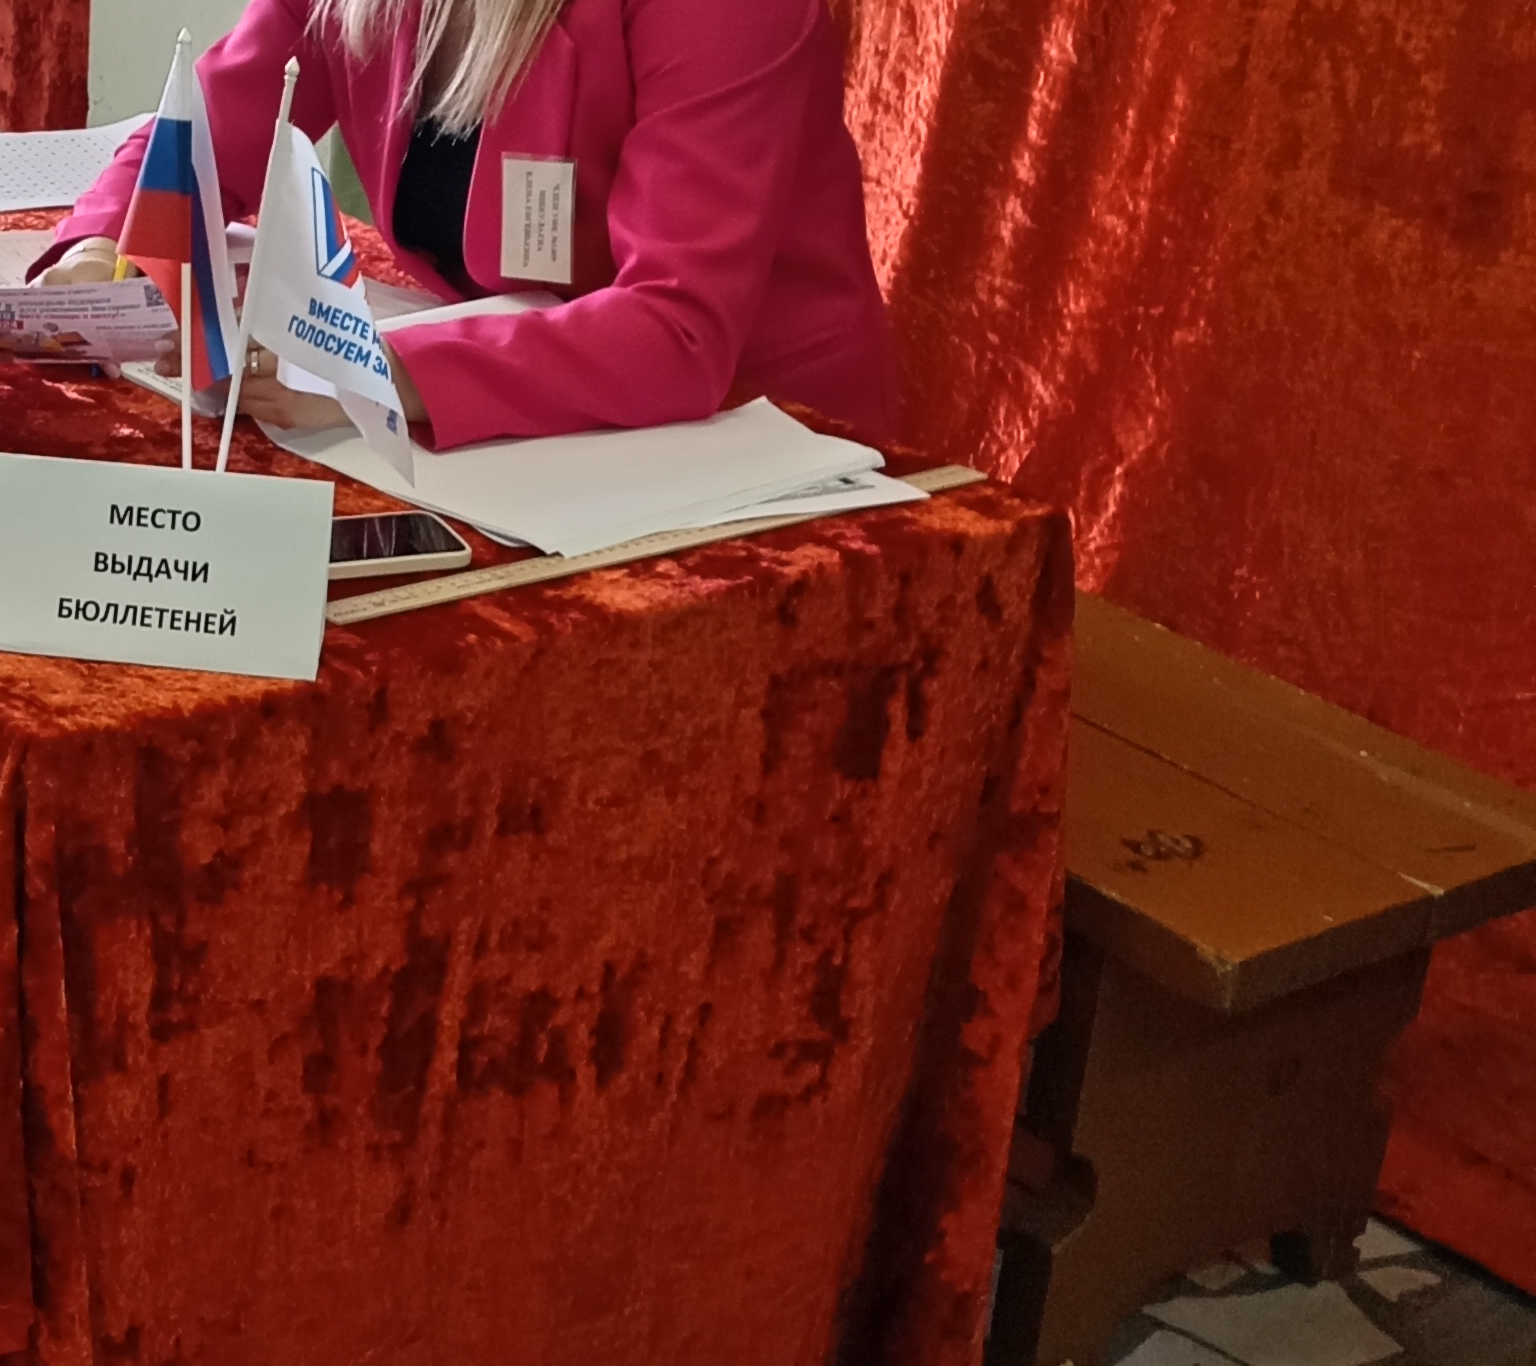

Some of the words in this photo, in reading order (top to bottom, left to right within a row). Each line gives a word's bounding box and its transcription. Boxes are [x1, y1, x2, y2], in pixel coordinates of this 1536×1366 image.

[308, 297, 371, 340] ВМЕСТЕ
[288, 315, 372, 368] ГОЛОСУЕМ
[372, 355, 389, 380] ЗА
[109, 504, 202, 532] МЕСТО
[93, 552, 210, 583] ВЫДАЧИ
[57, 597, 237, 637] БЮЛЛЕТЕНЕЙ
